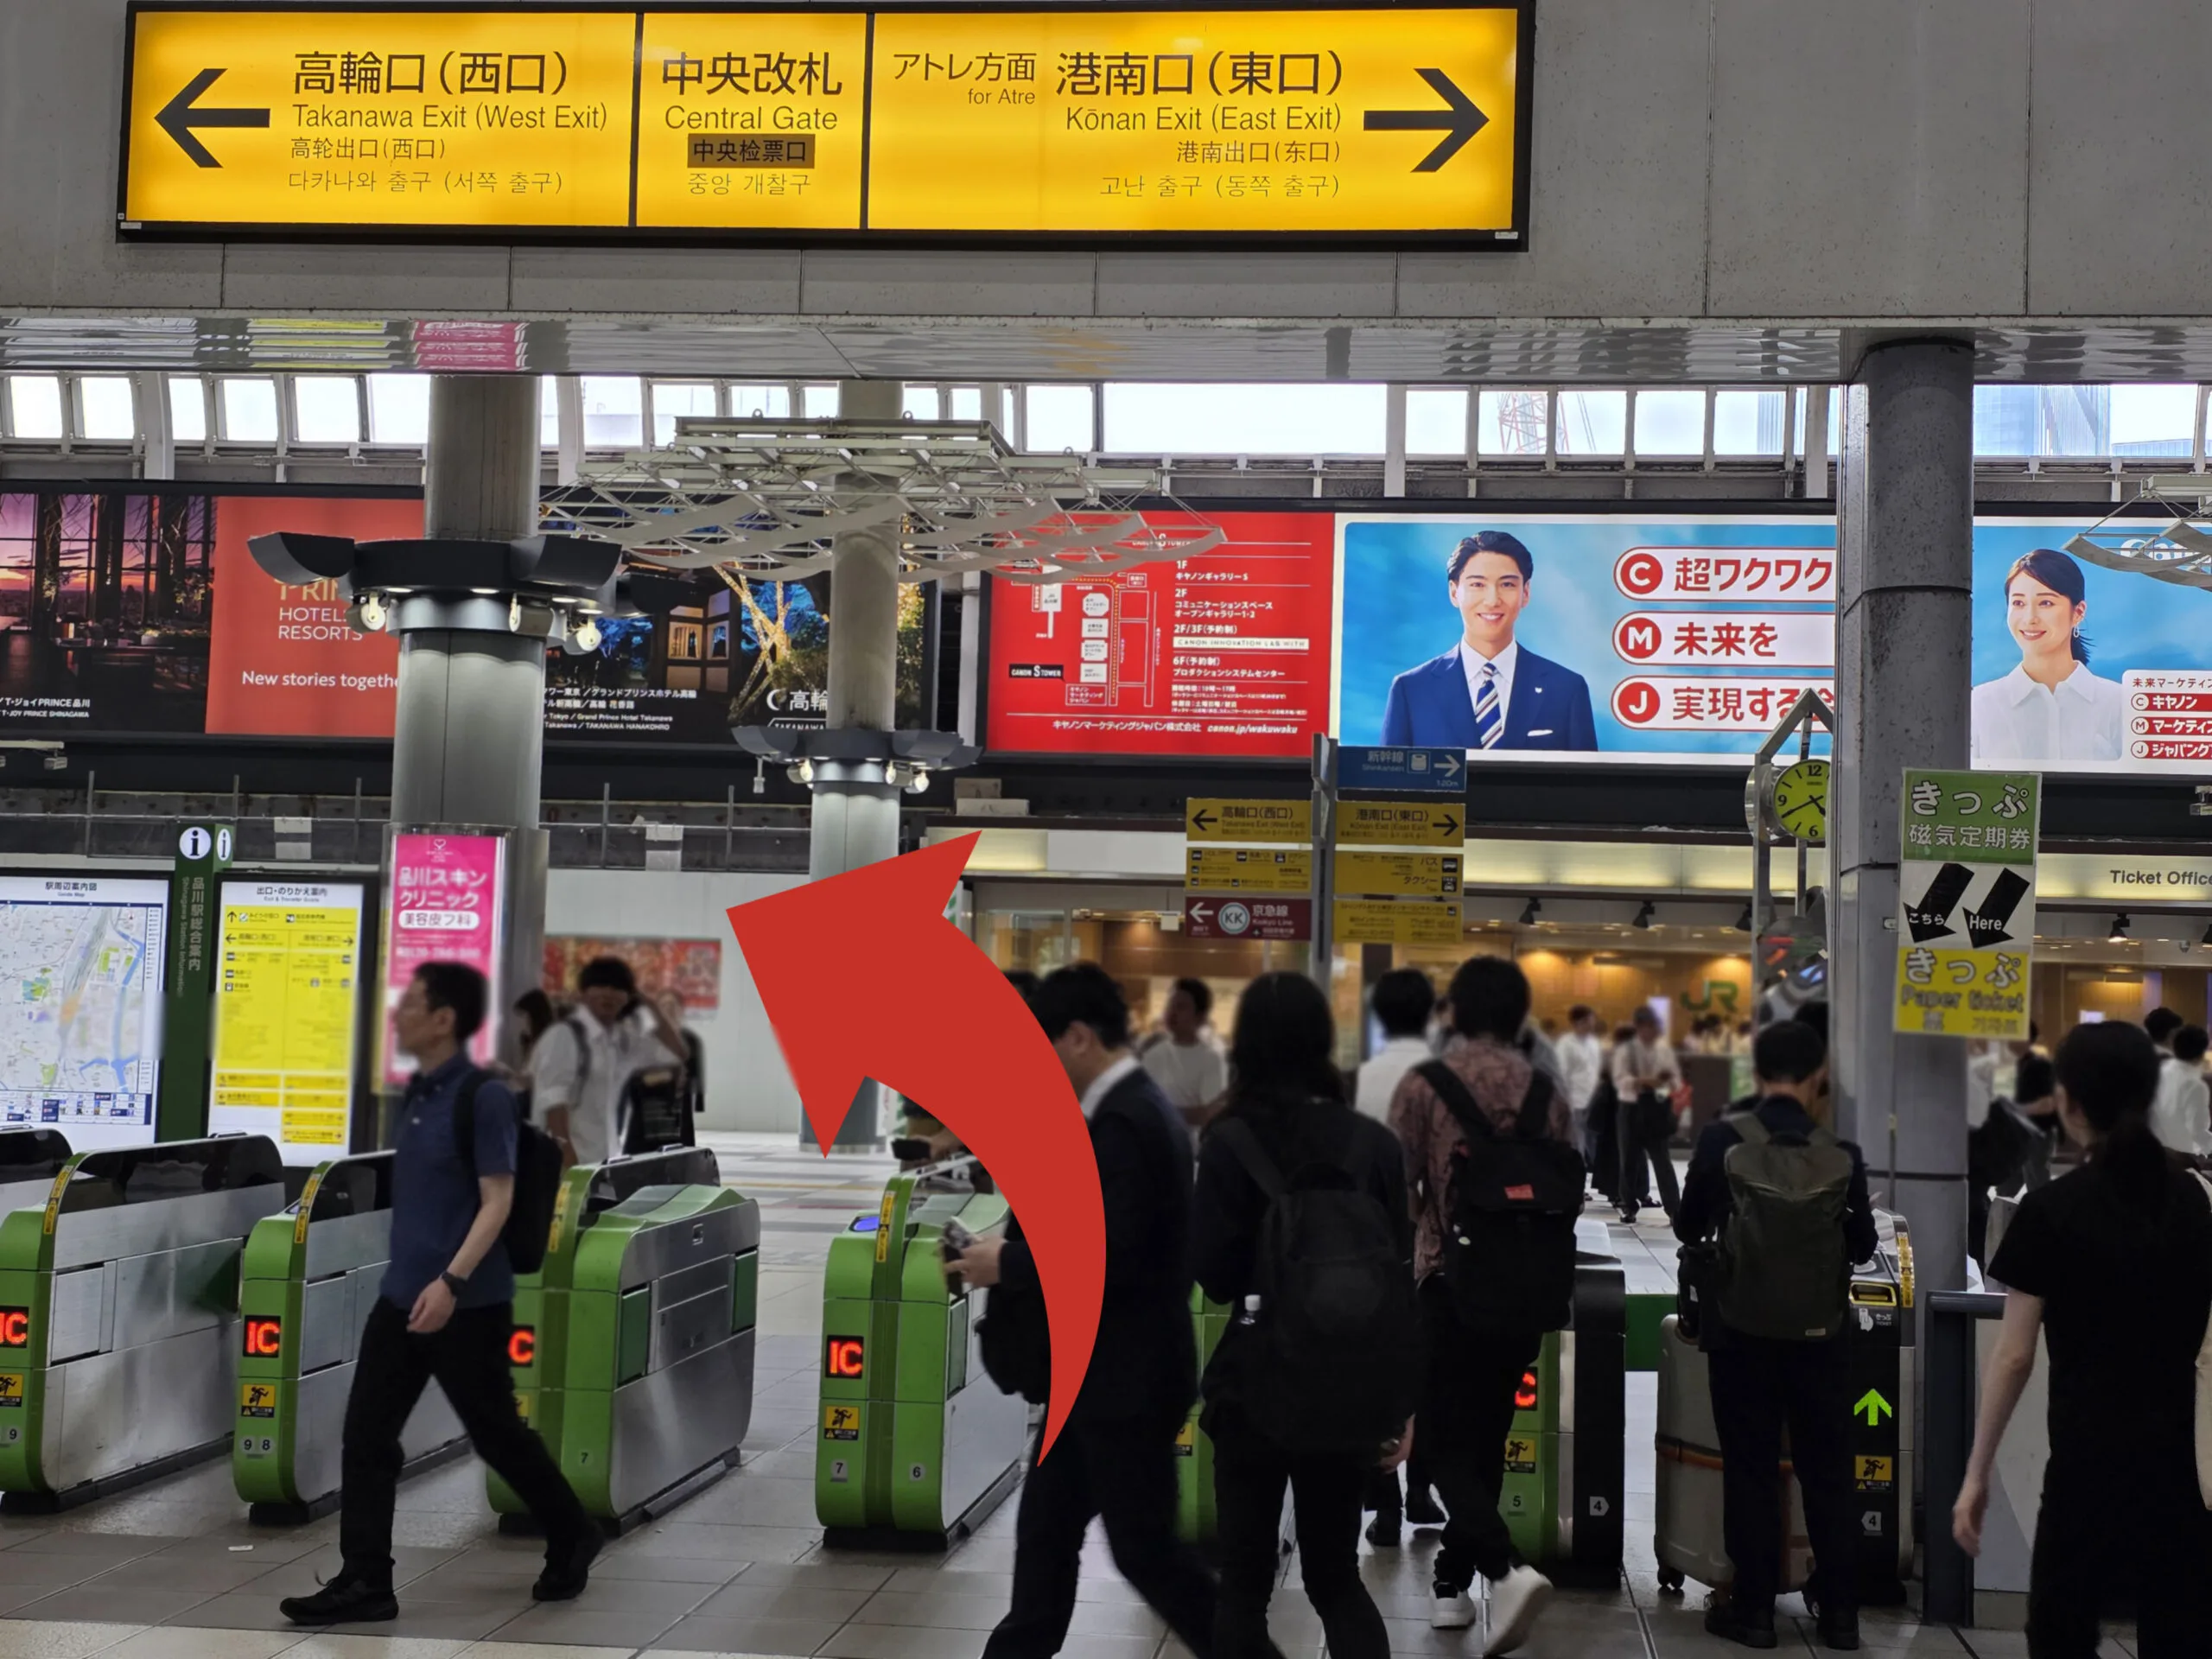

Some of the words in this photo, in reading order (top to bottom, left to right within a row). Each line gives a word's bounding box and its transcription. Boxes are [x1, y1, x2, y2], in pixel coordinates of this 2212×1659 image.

[662, 51, 843, 96] 中央改札
[893, 51, 1037, 82] アトレ方面
[968, 87, 992, 105] for
[997, 87, 1036, 105] Atre
[292, 104, 413, 128] Takanawa
[423, 105, 467, 129] Exit
[475, 102, 546, 131] (West
[554, 102, 607, 131] Exit)
[664, 105, 762, 130] Central
[772, 105, 838, 130] Gate
[1066, 105, 1146, 130] Kōnan
[1156, 106, 1203, 130] Exit
[1211, 103, 1277, 133] (East
[1286, 103, 1342, 133] Exit)
[693, 138, 807, 162] 中央检票口
[288, 170, 378, 193] 다카나와
[388, 171, 432, 194] 출구
[444, 170, 499, 194] (서쪽
[508, 171, 563, 194] 출구)
[688, 173, 732, 195] 중앙
[743, 173, 811, 196] 개찰구
[1099, 175, 1146, 198] 고난
[1156, 175, 1203, 198] 출구
[1215, 175, 1272, 199] (동쪽
[1281, 175, 1340, 199] 출구)
[1176, 560, 1188, 569] 1F
[1629, 561, 1652, 587] C
[1674, 556, 1833, 592] 超ワクワク
[1174, 588, 1188, 597] 2F
[279, 607, 347, 622] HOTEL
[1628, 626, 1653, 651] M
[1674, 621, 1779, 658] 未来を
[242, 671, 279, 686] New
[282, 672, 336, 686] stories
[1628, 690, 1648, 715] J
[2136, 697, 2144, 707] C
[2152, 695, 2198, 709] キヤノン
[2135, 721, 2145, 730] M
[1367, 750, 1405, 764] 新幹線
[2137, 745, 2144, 754] J
[1362, 764, 1405, 772] Shinkansen
[1808, 764, 1822, 777] 12
[1777, 794, 1788, 807] 9
[1910, 779, 2031, 820] きっぷ
[1808, 823, 1819, 837] 6
[1909, 823, 2031, 850] 磁気定期券
[397, 866, 488, 887] 品川スキン
[2109, 869, 2162, 884] Ticket
[399, 889, 480, 909] クリニック
[1224, 912, 1243, 924] KK
[1252, 904, 1288, 917] 京急線
[404, 912, 471, 927] 美容皮フ科
[1909, 912, 1945, 925] こちら
[1969, 915, 2003, 931] Here
[1905, 946, 2022, 989] きっぷ
[1681, 979, 1739, 1013] JR
[246, 1321, 281, 1355] IC
[508, 1330, 535, 1364] C
[830, 1340, 863, 1376] IC
[9, 1428, 17, 1440] 9
[244, 1439, 252, 1451] 9
[262, 1439, 270, 1451] 8
[581, 1452, 588, 1465] 7
[836, 1462, 844, 1474] 7
[912, 1465, 921, 1478] 6
[1513, 1495, 1522, 1508] 5
[1593, 1500, 1602, 1512] 4
[1868, 1514, 1877, 1527] 4
